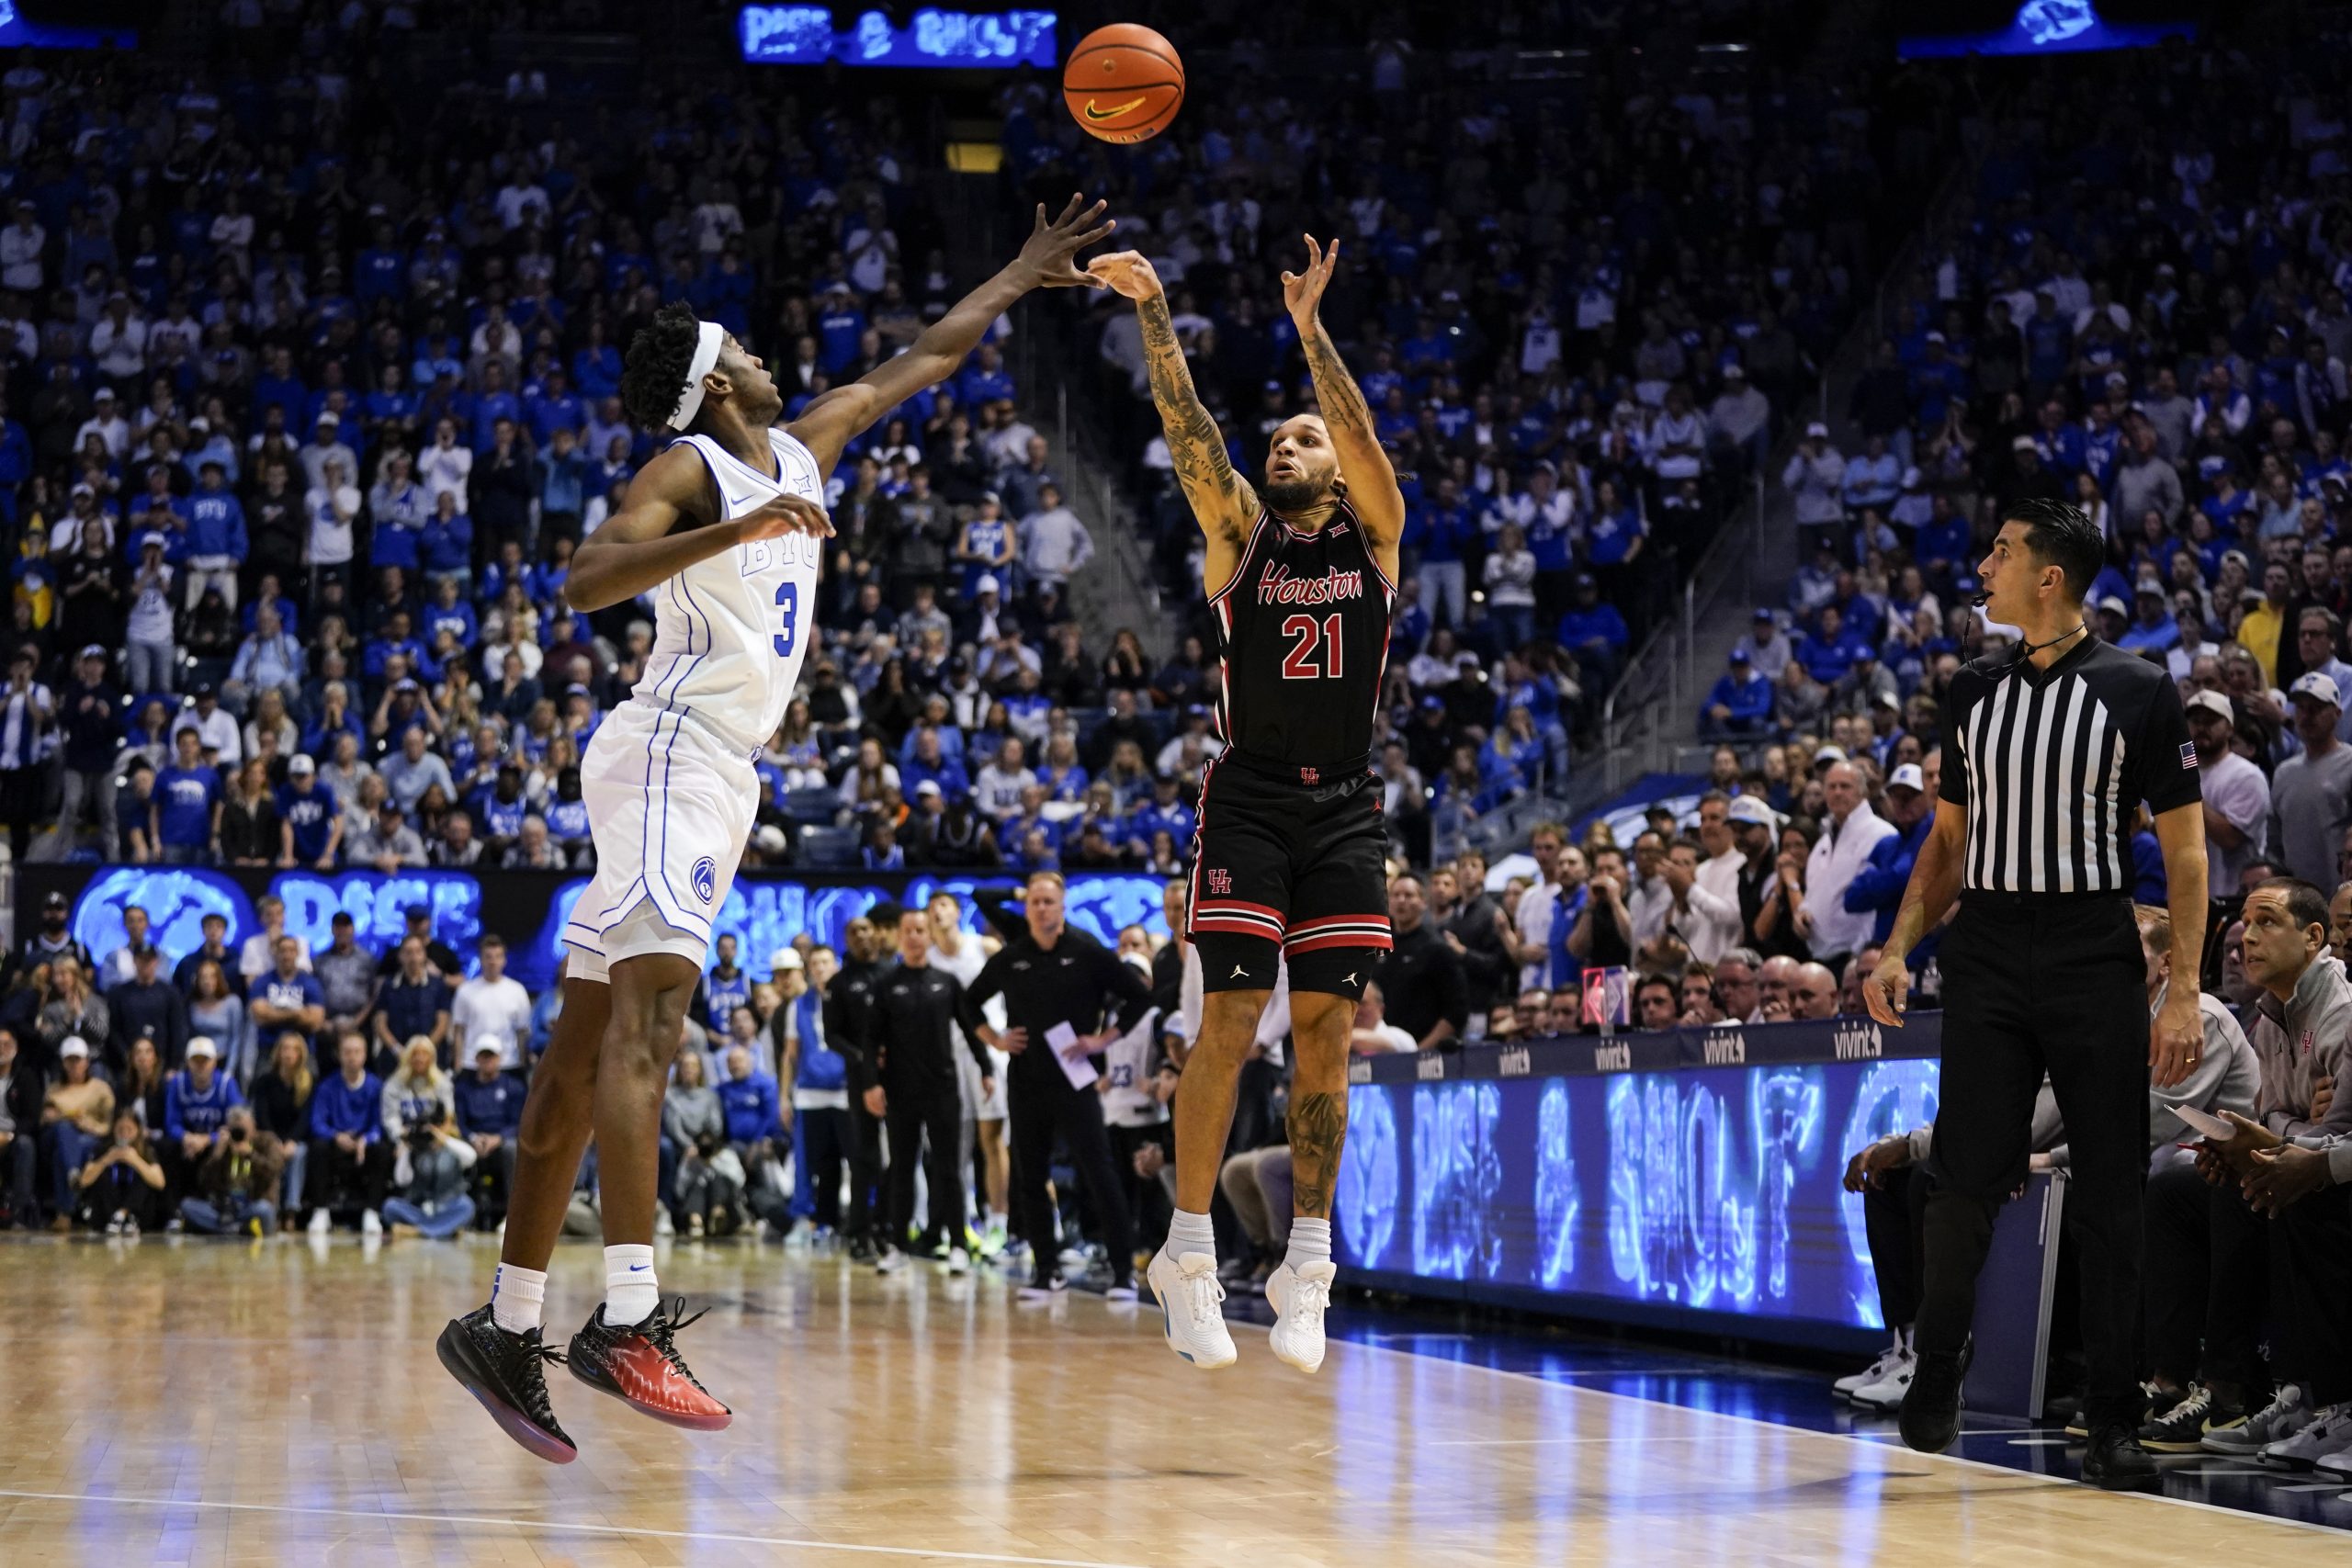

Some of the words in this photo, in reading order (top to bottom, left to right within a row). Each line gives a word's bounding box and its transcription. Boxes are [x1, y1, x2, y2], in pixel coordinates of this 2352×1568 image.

[1257, 558, 1363, 606] Houston
[774, 581, 798, 658] 3
[1282, 613, 1344, 680] 21
[1208, 869, 1232, 894] UH
[1595, 1040, 1622, 1071] vivint
[1703, 1030, 1736, 1066] vivint
[1835, 1021, 1872, 1061] vivint
